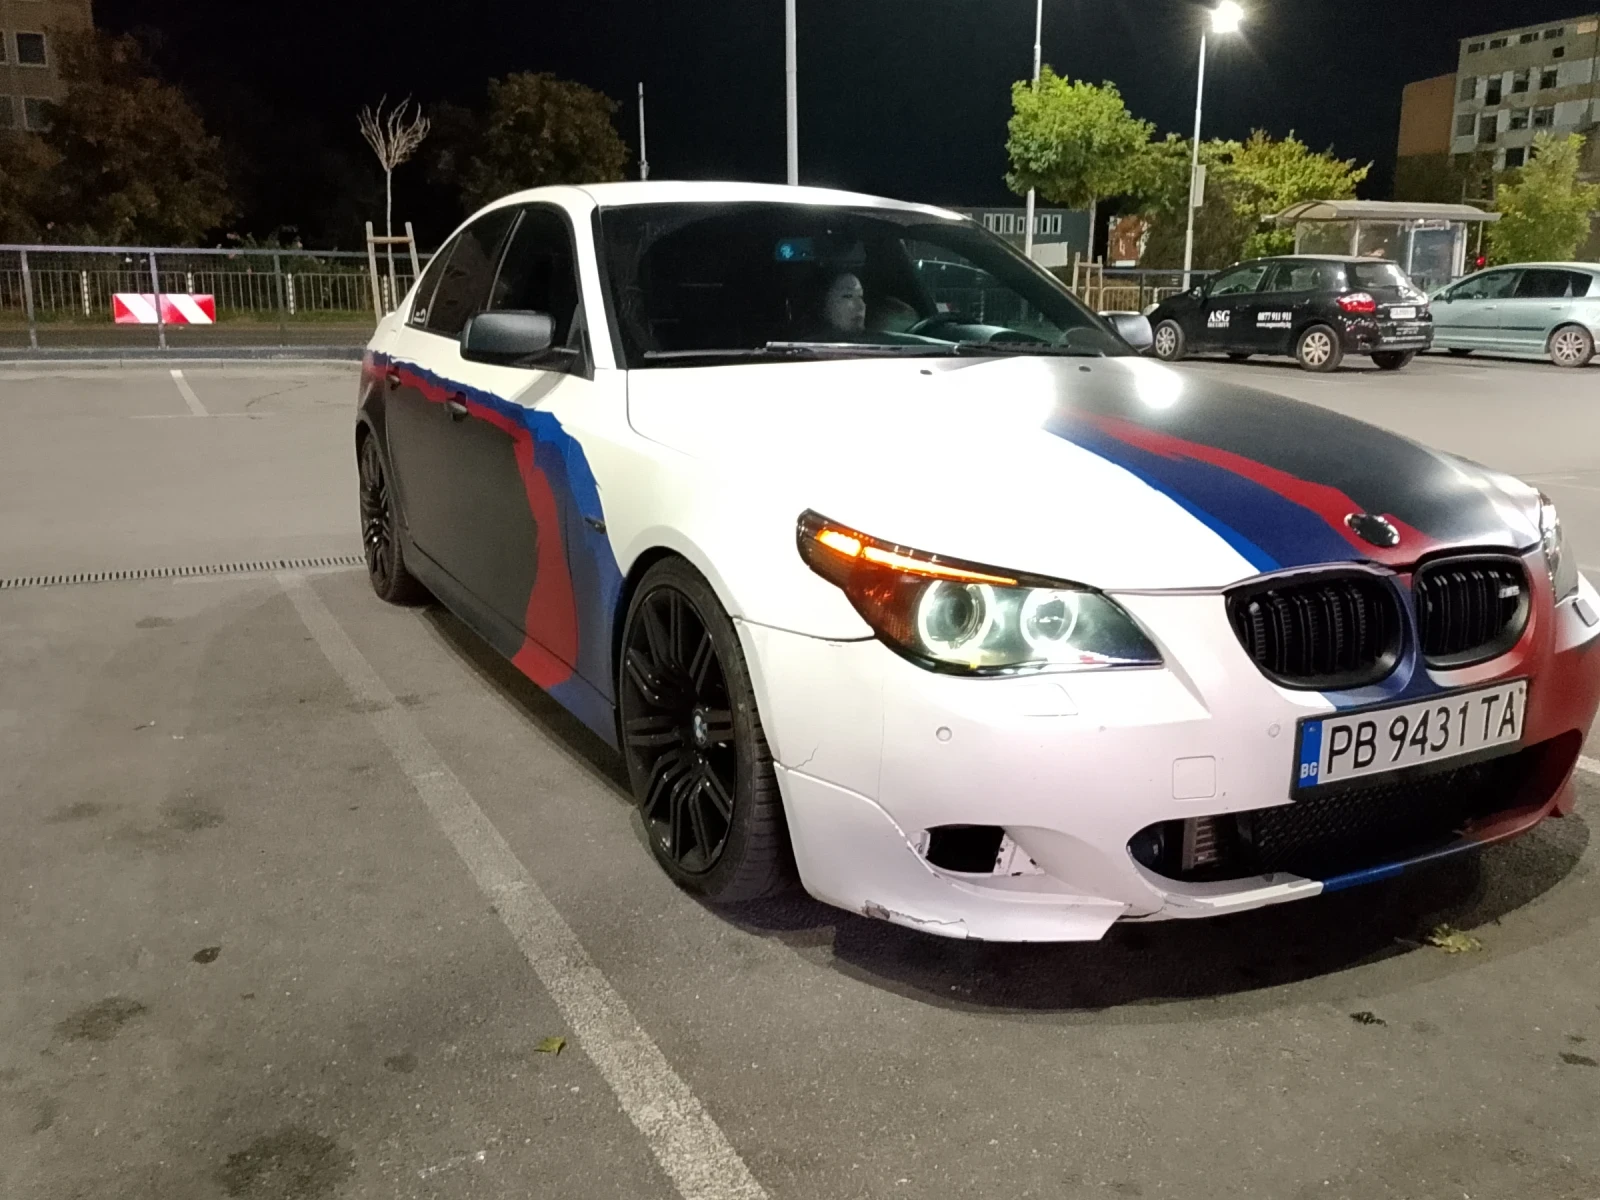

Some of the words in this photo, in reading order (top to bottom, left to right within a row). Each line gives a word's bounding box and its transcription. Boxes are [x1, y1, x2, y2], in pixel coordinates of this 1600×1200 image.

[1208, 310, 1231, 322] ASG
[1271, 311, 1282, 321] 911
[1282, 311, 1292, 321] 911
[1327, 720, 1377, 775] PB
[1388, 701, 1470, 762] 9431
[1481, 691, 1516, 741] TA
[1300, 762, 1318, 779] BG
